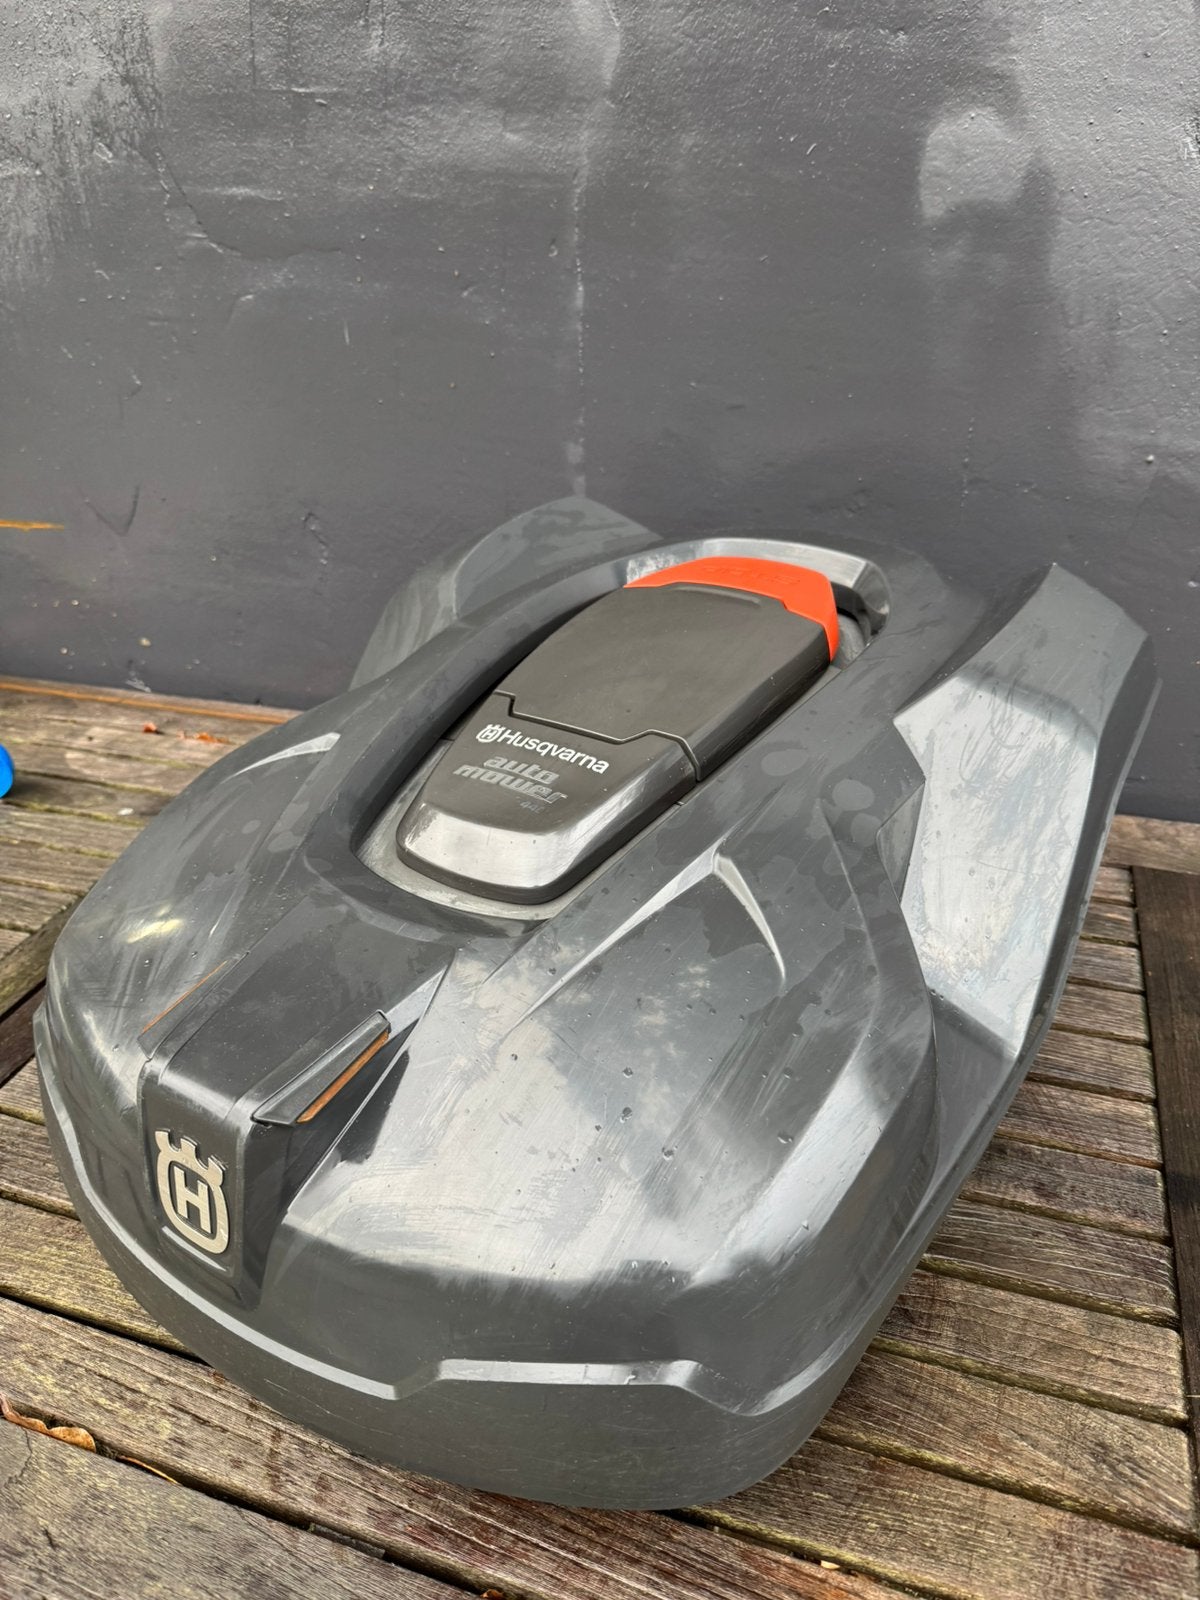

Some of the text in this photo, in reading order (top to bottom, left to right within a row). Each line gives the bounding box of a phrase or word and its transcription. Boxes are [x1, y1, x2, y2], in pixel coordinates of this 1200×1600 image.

[483, 756, 560, 785] auto
[497, 730, 610, 775] Husqvarna
[453, 764, 568, 804] mower
